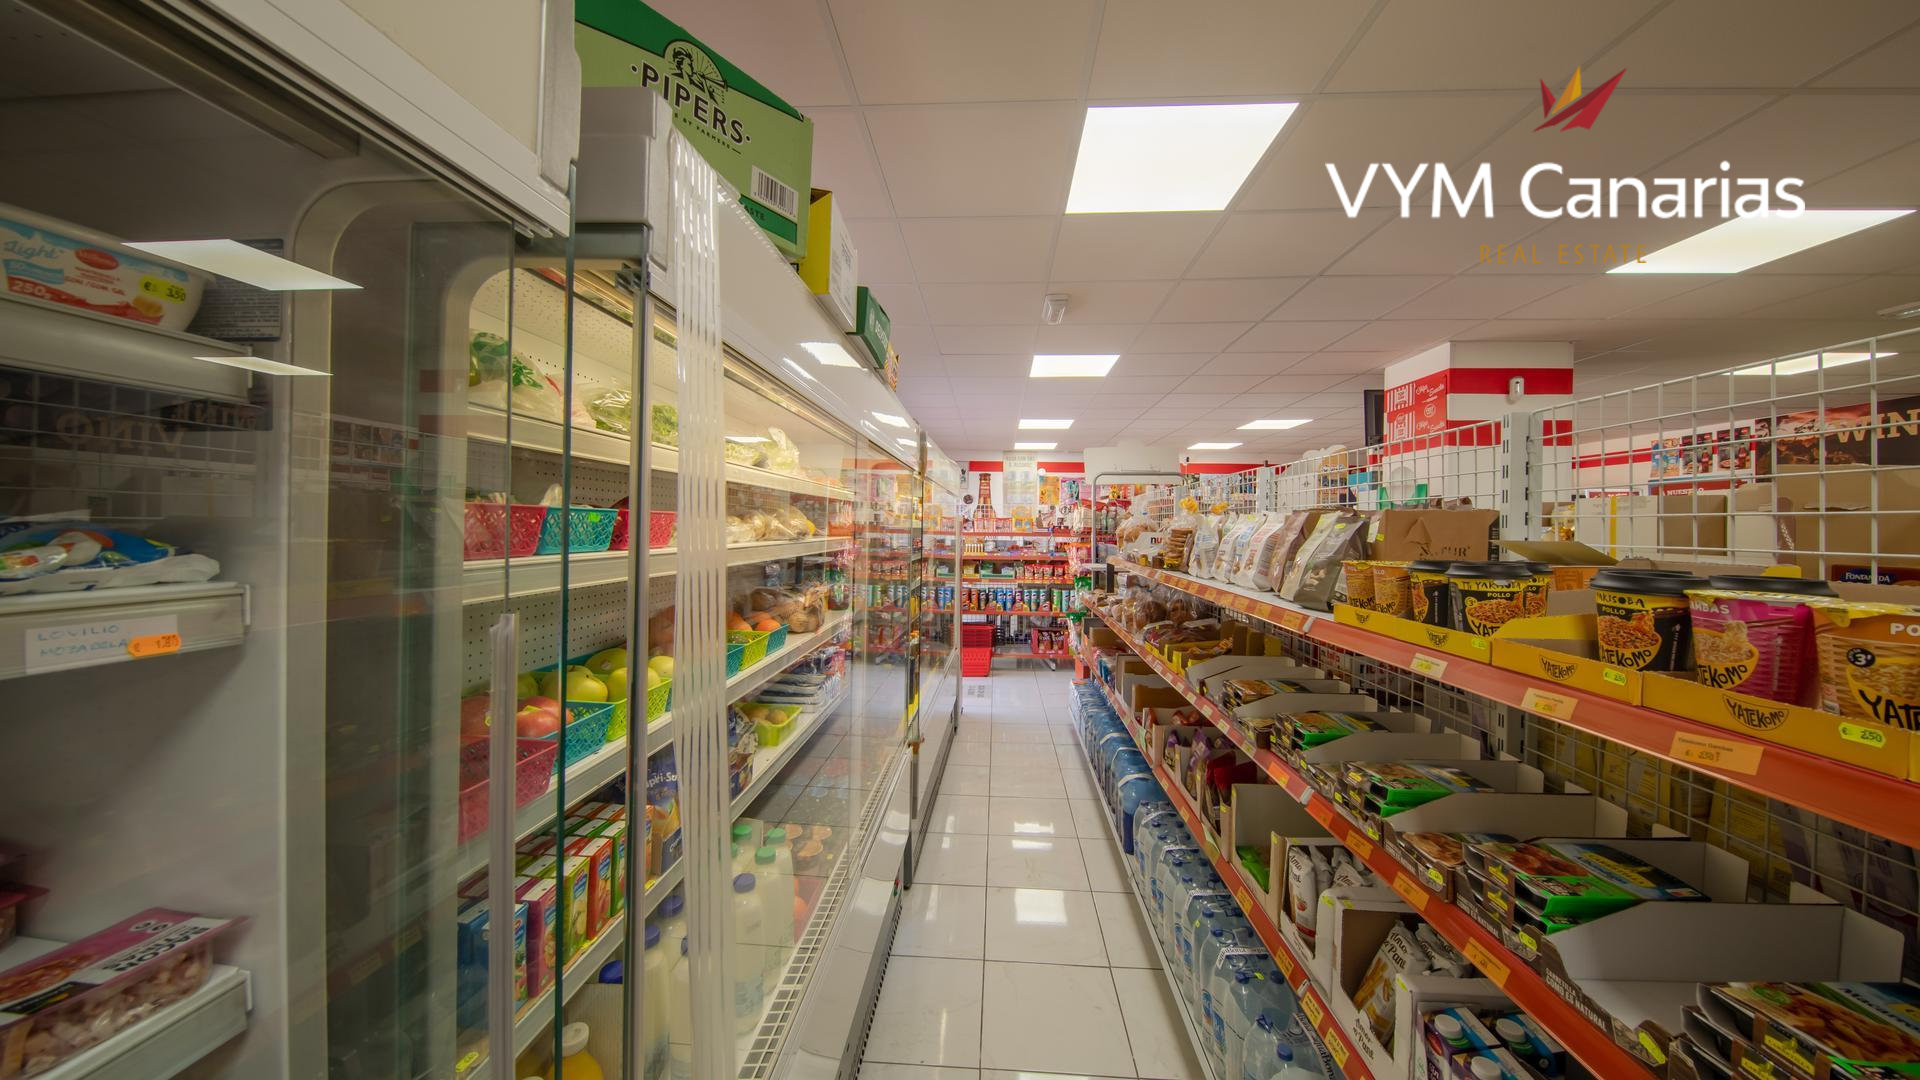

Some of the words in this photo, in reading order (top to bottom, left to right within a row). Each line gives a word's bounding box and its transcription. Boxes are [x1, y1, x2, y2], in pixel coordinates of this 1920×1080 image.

[640, 61, 746, 145] PIPERS
[1845, 572, 1891, 583] FONTADA
[1599, 593, 1645, 608] AKISOBA
[1690, 601, 1730, 615] AMBAS
[1601, 606, 1627, 616] POLLO
[1602, 649, 1652, 669] ATEKOMO
[1726, 697, 1786, 729] YATEKOMO
